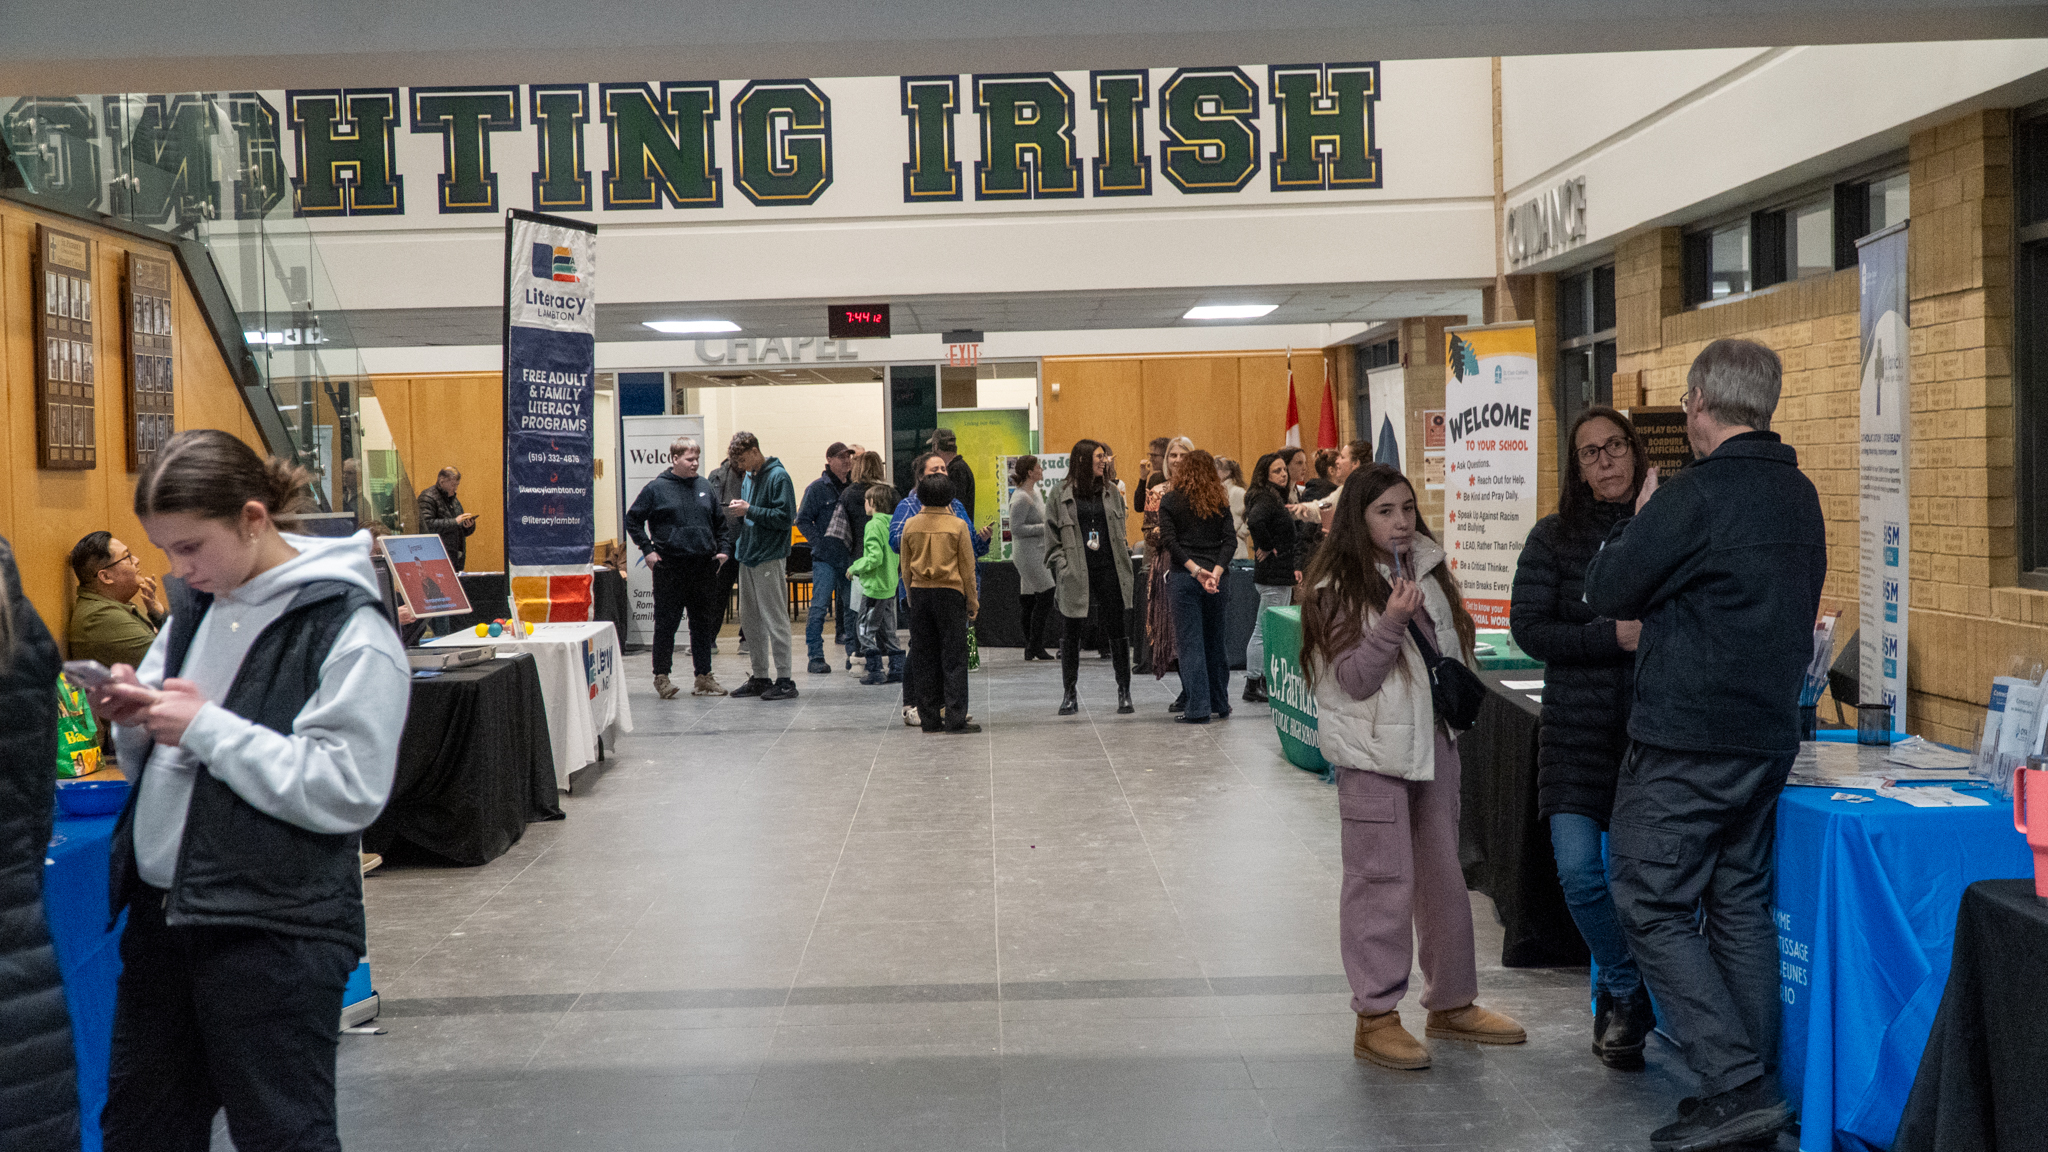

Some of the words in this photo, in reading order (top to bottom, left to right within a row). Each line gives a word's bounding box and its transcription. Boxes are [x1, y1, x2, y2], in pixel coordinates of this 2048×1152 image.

[901, 61, 1383, 203] IRISH
[1506, 174, 1587, 264] GUIDANCE
[526, 287, 586, 315] Literacy
[537, 308, 575, 321] LAMBTON
[846, 311, 871, 323] 7:44
[873, 313, 883, 323] 12
[694, 337, 858, 364] CHAPEL
[950, 343, 980, 367] EXIT
[523, 368, 547, 383] FREE
[549, 371, 588, 387] ADULT
[529, 385, 538, 398] &
[540, 386, 582, 401] FAMILY
[528, 400, 581, 416] LITERACY
[521, 415, 587, 432] PROGRAMS
[1448, 402, 1532, 444] WELCOME
[1635, 425, 1666, 434] DISPLAY
[1466, 439, 1475, 451] TO
[1477, 439, 1496, 452] YOUR
[1499, 439, 1529, 452] SCHOOL
[528, 451, 547, 464] (519)
[547, 453, 580, 463] 332-4876
[1457, 460, 1466, 470] Ask
[1467, 459, 1491, 470] Questions.
[1477, 475, 1492, 485] Reach
[1493, 475, 1504, 485] Out
[1504, 474, 1512, 484] for
[1512, 474, 1526, 486] Help.
[518, 485, 587, 497] literacylambton.org
[1463, 492, 1470, 502] Be
[1471, 491, 1480, 501] Kind
[1481, 491, 1491, 501] and
[1491, 490, 1504, 502] Pray
[1505, 490, 1519, 502] Daily.
[1457, 510, 1472, 521] Speak
[1473, 510, 1479, 521] Up
[1480, 511, 1499, 522] Against
[1500, 511, 1520, 521] Racism
[1457, 522, 1467, 532] and
[1467, 522, 1487, 534] Bullying.
[1462, 541, 1477, 551] LEAD,
[1477, 541, 1492, 551] Rather
[1494, 541, 1508, 551] Than
[1460, 560, 1467, 570] Be
[1467, 562, 1471, 570] a
[1471, 561, 1487, 571] Critical
[1487, 562, 1510, 573] Thinker.
[1464, 580, 1475, 589] Brain
[1476, 580, 1492, 590] Breaks
[1493, 581, 1510, 593] Every
[1465, 601, 1473, 610] Get
[1474, 602, 1478, 611] to
[1478, 602, 1490, 612] know
[1491, 605, 1504, 615] your
[1269, 653, 1280, 701] St.
[1280, 657, 1319, 719] Patrick's
